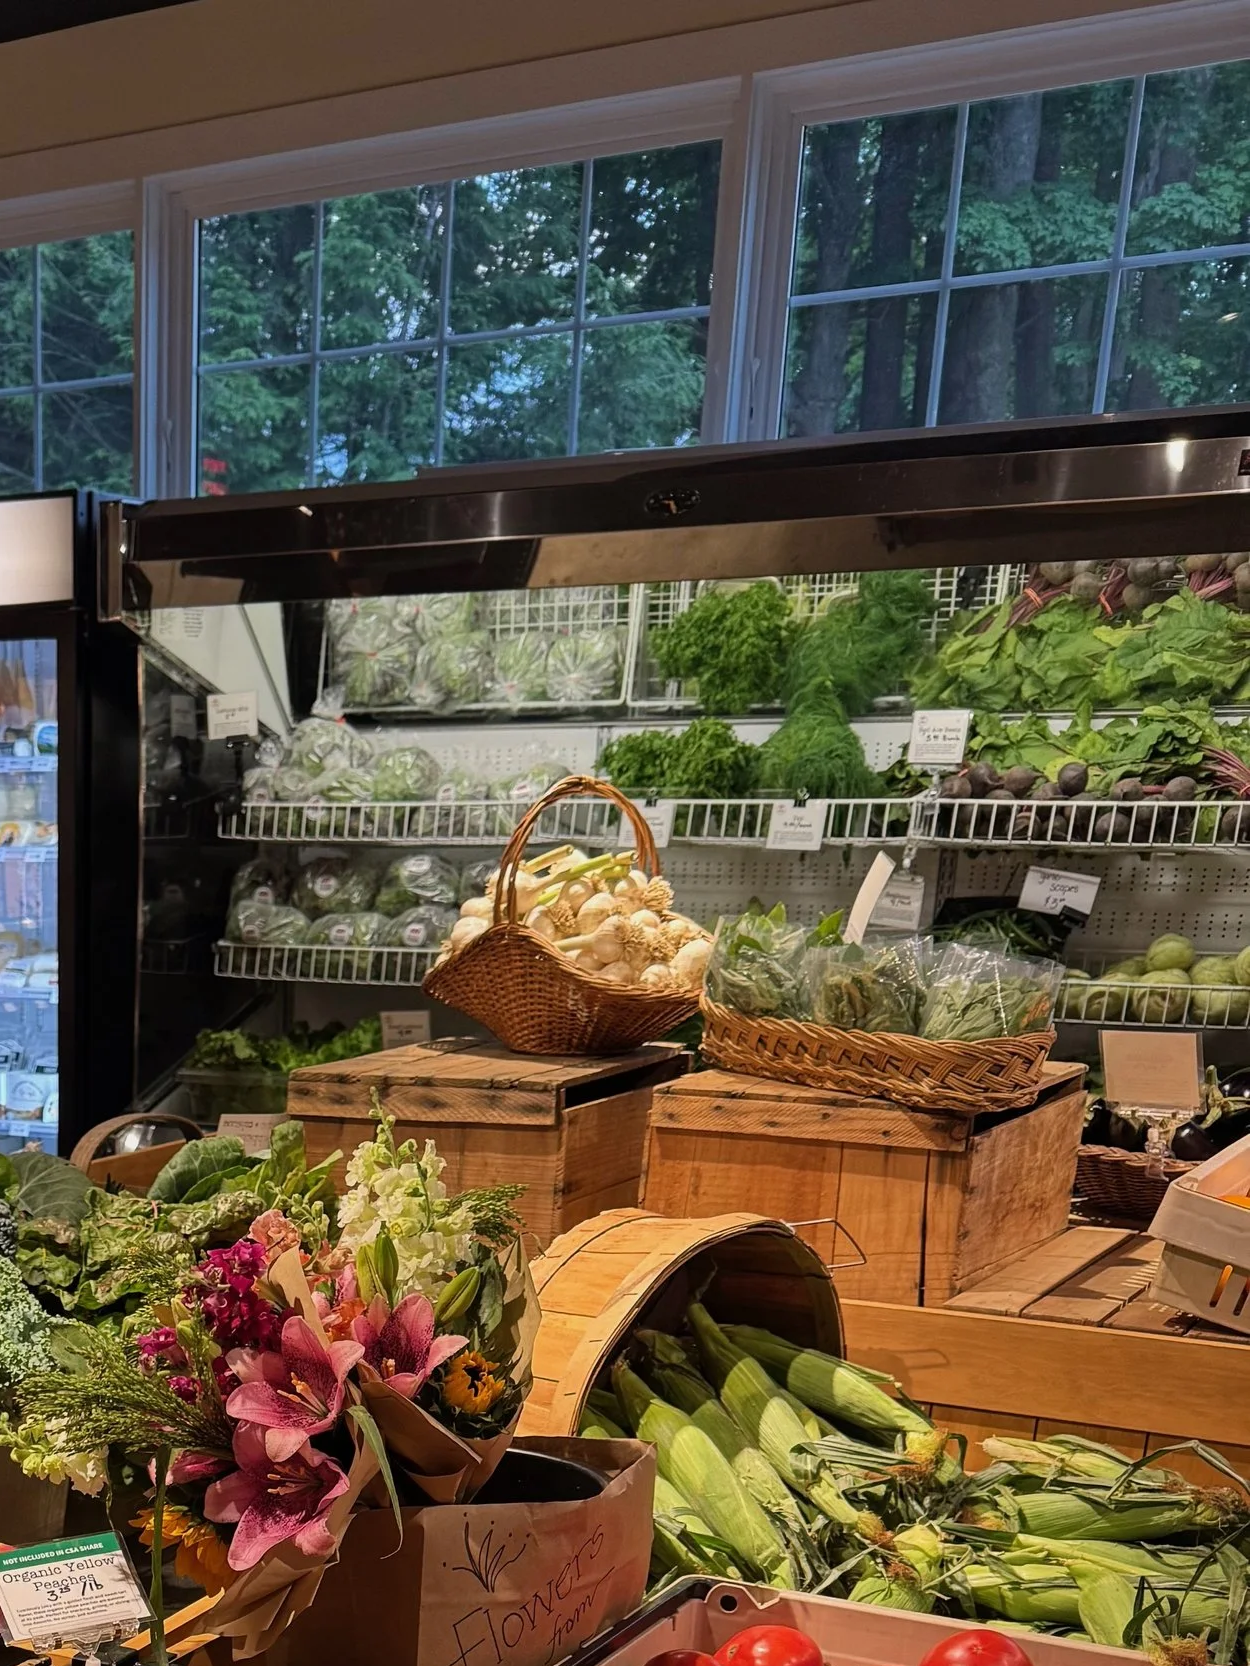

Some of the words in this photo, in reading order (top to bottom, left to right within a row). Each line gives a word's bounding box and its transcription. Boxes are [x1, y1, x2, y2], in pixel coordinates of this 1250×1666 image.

[2, 1557, 18, 1566] NOT
[19, 1550, 55, 1562] INCLUDED
[64, 1546, 80, 1555] CSA
[80, 1542, 104, 1552] SHARE
[2, 1566, 62, 1584] Organic
[64, 1556, 115, 1572] Yellow
[33, 1573, 96, 1592] Peaches
[544, 1566, 616, 1666] from
